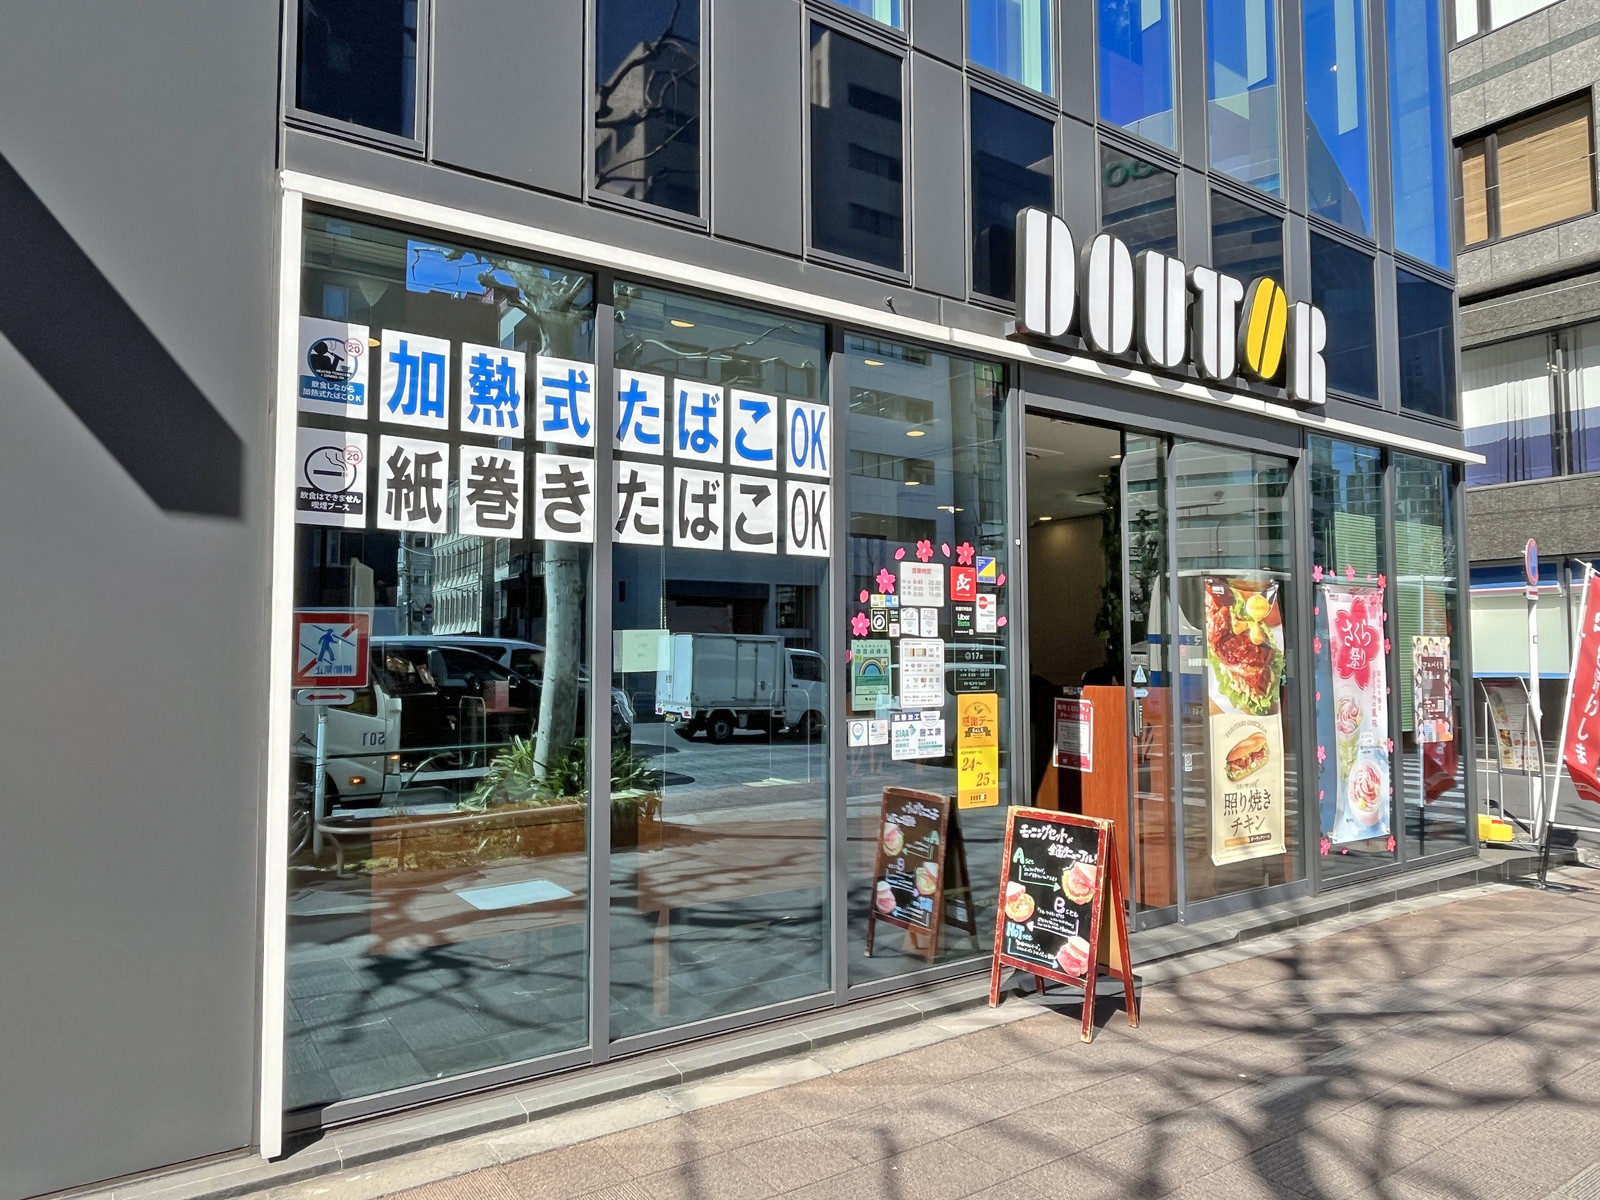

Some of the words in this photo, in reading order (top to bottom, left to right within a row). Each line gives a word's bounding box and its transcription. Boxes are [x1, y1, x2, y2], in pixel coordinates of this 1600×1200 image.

[1020, 207, 1326, 406] DOUTOR
[348, 344, 361, 353] 20
[302, 388, 362, 402] 加熱式たばこOK
[312, 380, 355, 393] 飲食しながら
[387, 339, 827, 471] 加熱式たばこOK
[347, 452, 359, 461] 20
[300, 491, 361, 504] 飲食はできません
[311, 501, 350, 511] 喫煙ブース
[385, 445, 827, 550] 紙巻きたばこOK
[1341, 619, 1371, 647] さくら
[1346, 647, 1366, 668] 祭り
[895, 729, 909, 738] SIAA
[1223, 789, 1271, 817] 照り焼き
[1231, 815, 1266, 836] チキン
[1013, 847, 1024, 864] A
[1054, 897, 1065, 914] B
